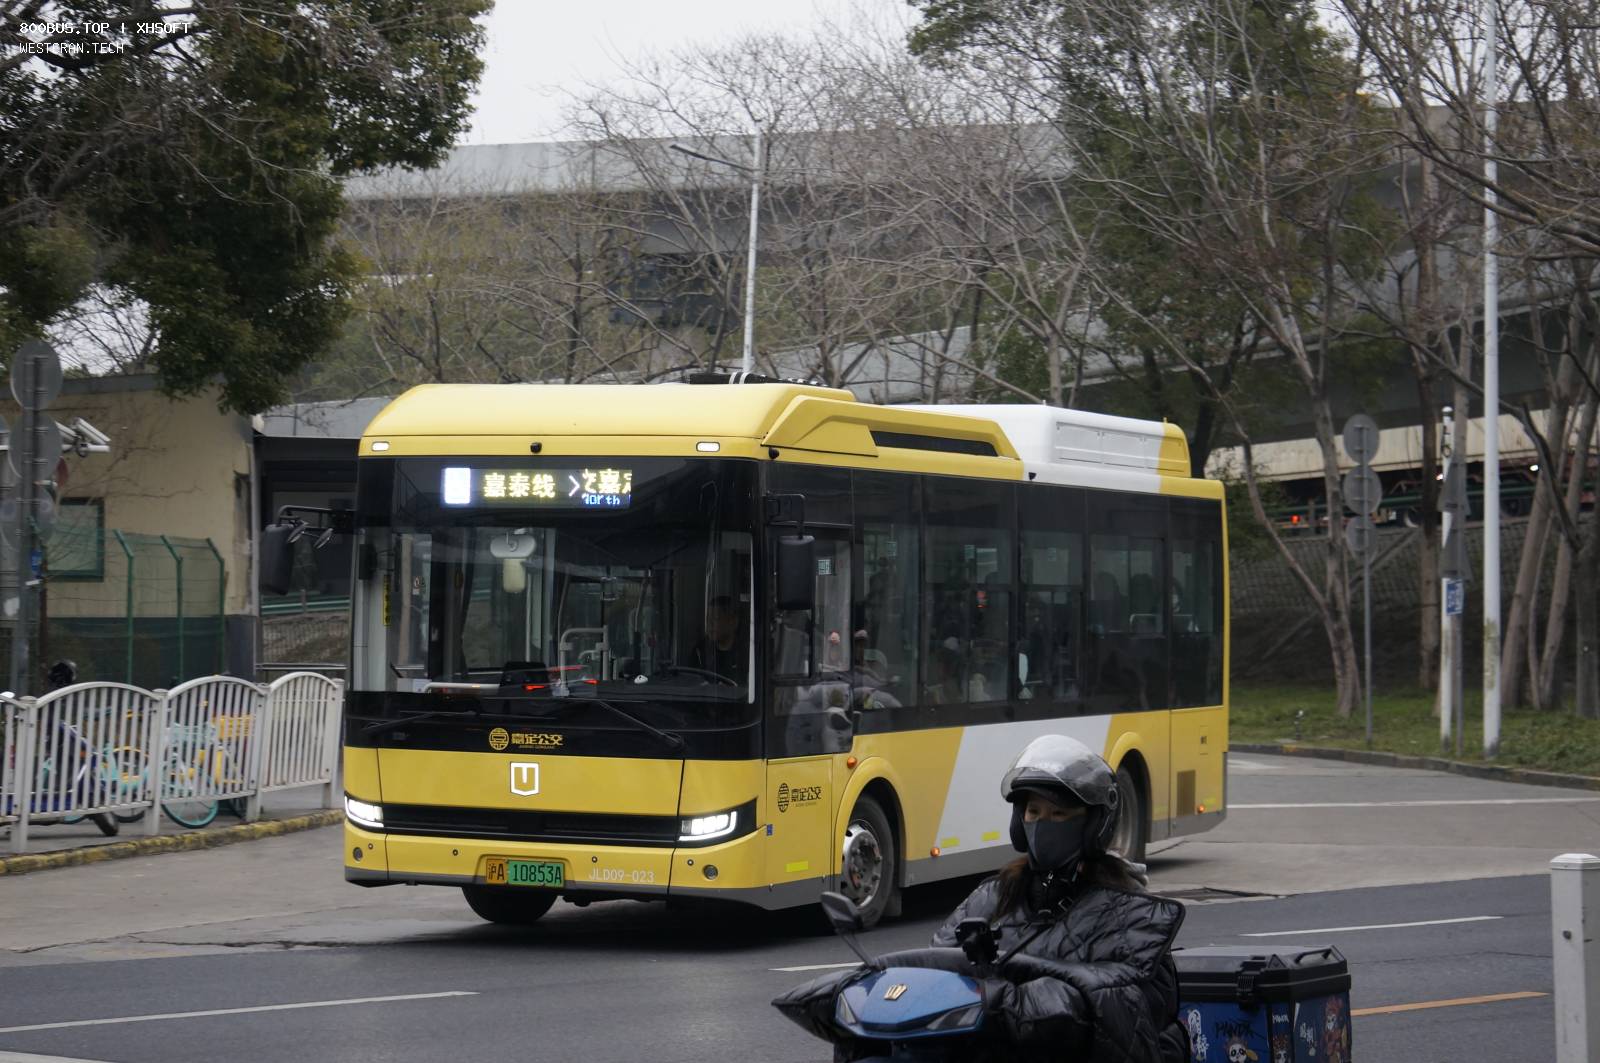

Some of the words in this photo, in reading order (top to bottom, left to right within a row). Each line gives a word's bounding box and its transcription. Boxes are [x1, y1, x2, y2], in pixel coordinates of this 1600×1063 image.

[483, 472, 556, 498] 嘉泰线
[511, 732, 564, 746] 嘉定公交
[588, 867, 655, 883] JLD09-023
